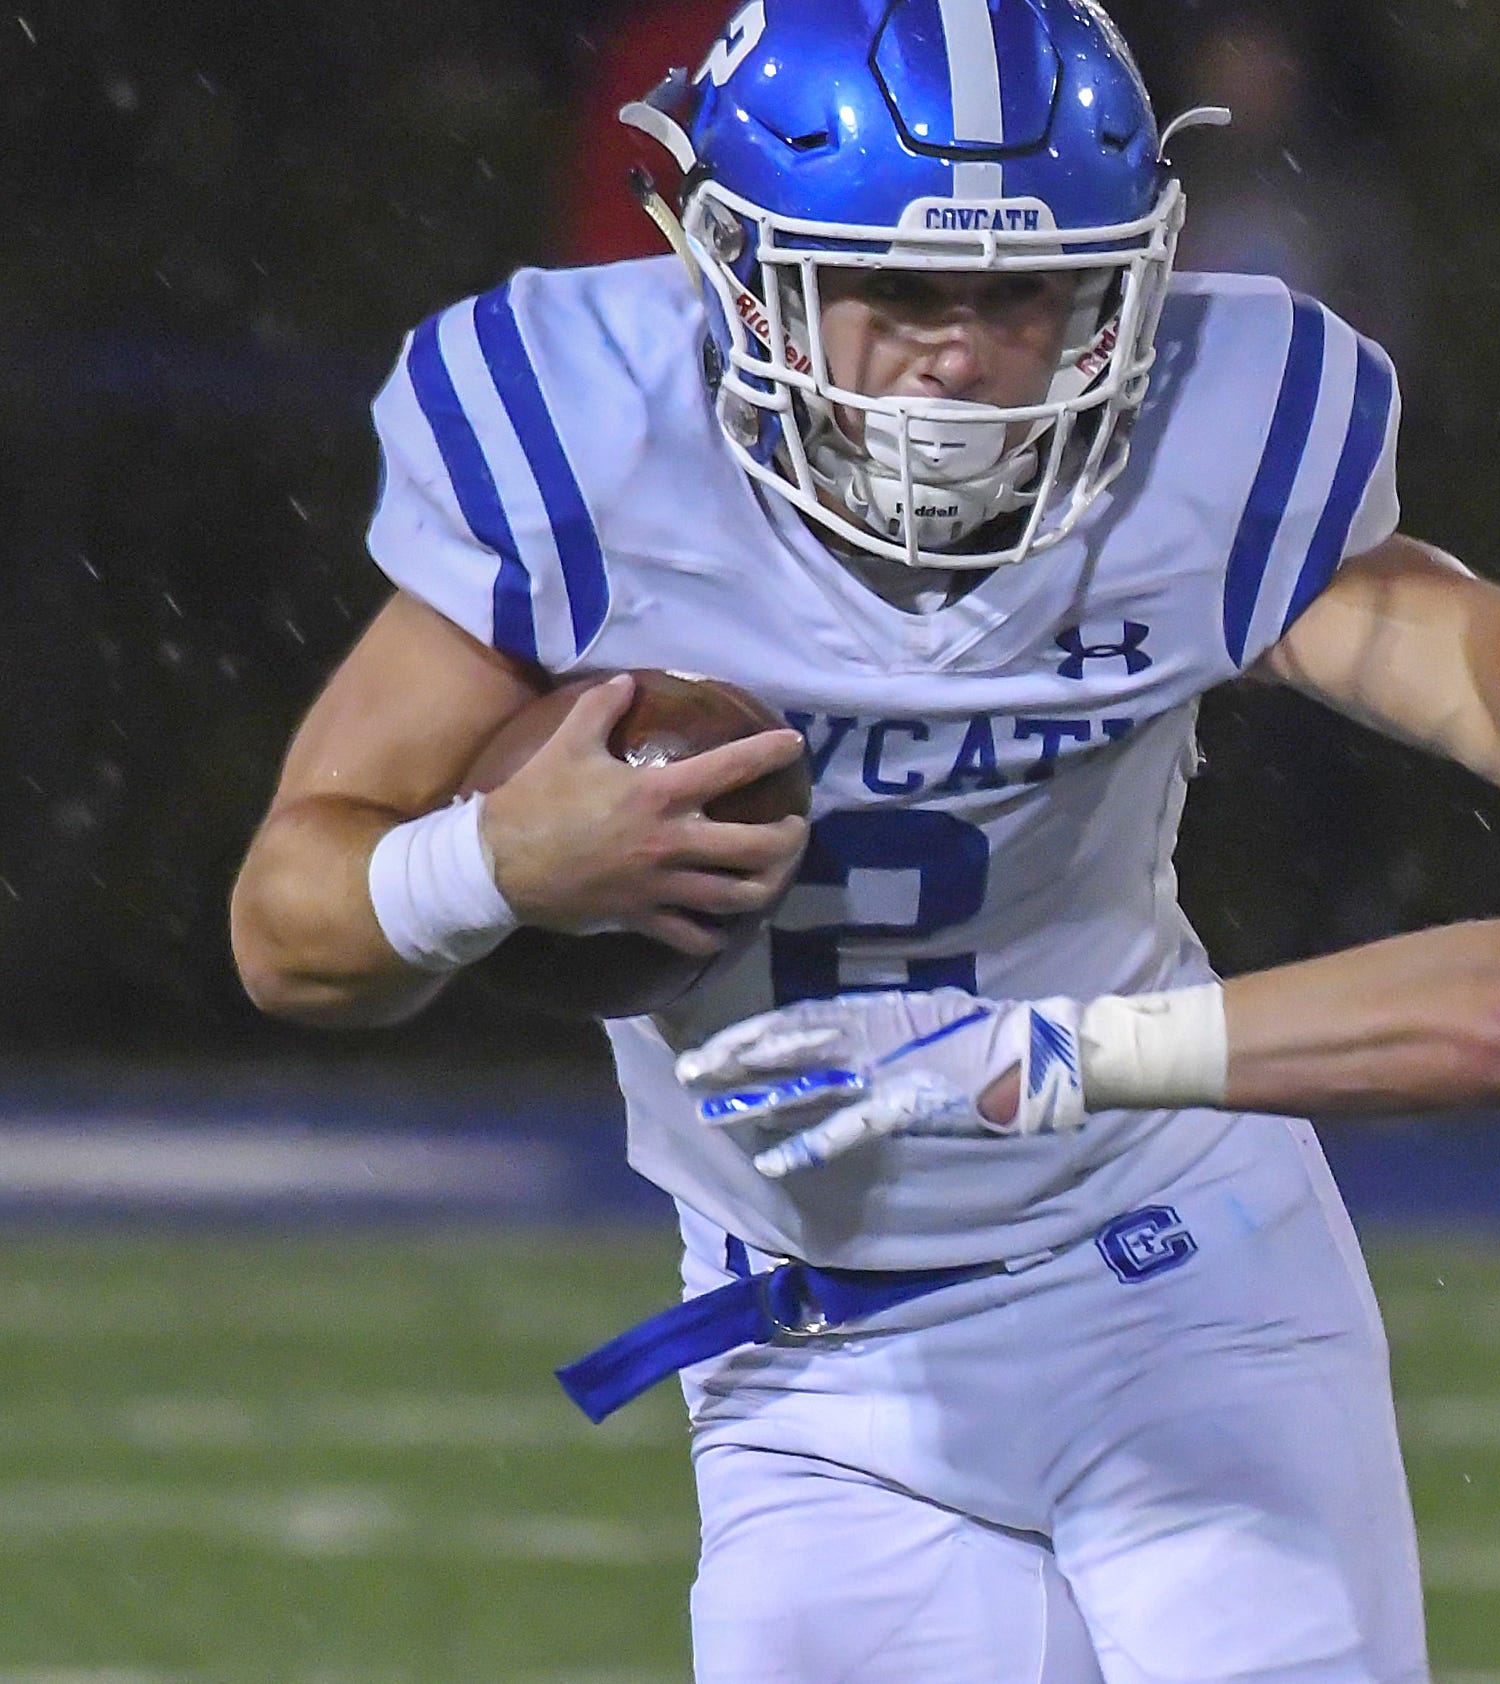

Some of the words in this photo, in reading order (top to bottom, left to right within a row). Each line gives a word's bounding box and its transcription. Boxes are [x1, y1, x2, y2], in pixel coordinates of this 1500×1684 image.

[692, 0, 766, 87] 2
[926, 208, 1039, 230] COVCATH
[736, 293, 812, 375] Ridell
[896, 502, 958, 517] Rddell
[768, 808, 990, 1006] 2
[1094, 1205, 1198, 1284] C
